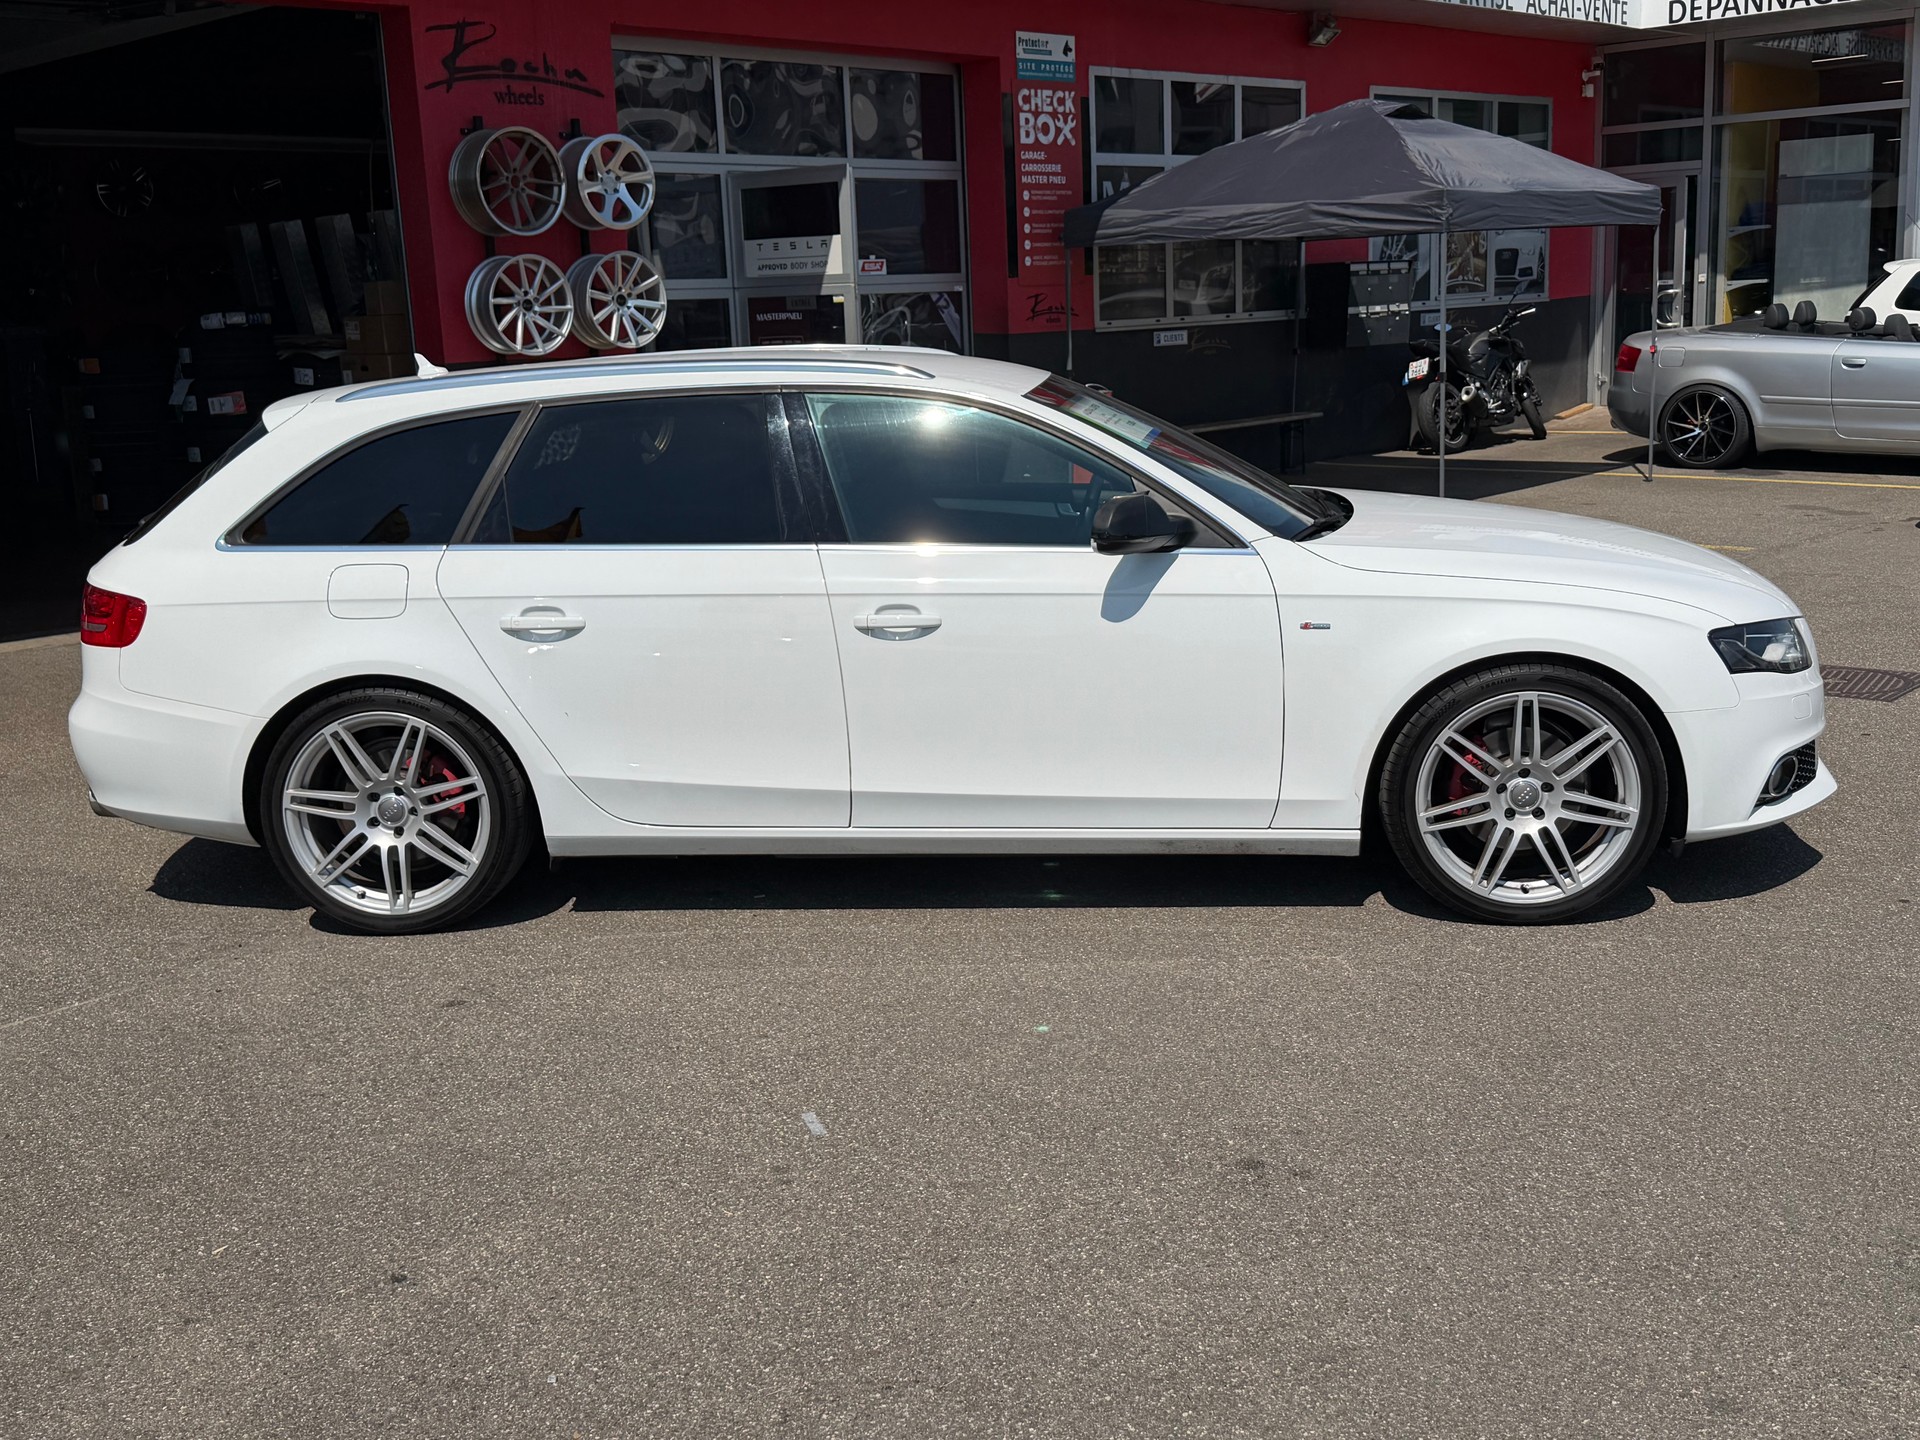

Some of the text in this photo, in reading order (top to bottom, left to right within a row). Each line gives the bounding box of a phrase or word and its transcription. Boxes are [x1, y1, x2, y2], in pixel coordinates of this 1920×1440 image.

[1018, 62, 1036, 71] SITE
[494, 84, 545, 106] wheels
[1017, 88, 1076, 114] CHECK
[1019, 112, 1077, 146] BOX
[1021, 163, 1062, 173] CARROSSERIE
[1021, 175, 1067, 184] MASTER PNEU
[756, 239, 828, 252] TESLA
[757, 260, 829, 271] APPROVED BODY SHOP
[756, 312, 803, 321] MASTERPNEU
[1163, 333, 1184, 343] CLIENTS
